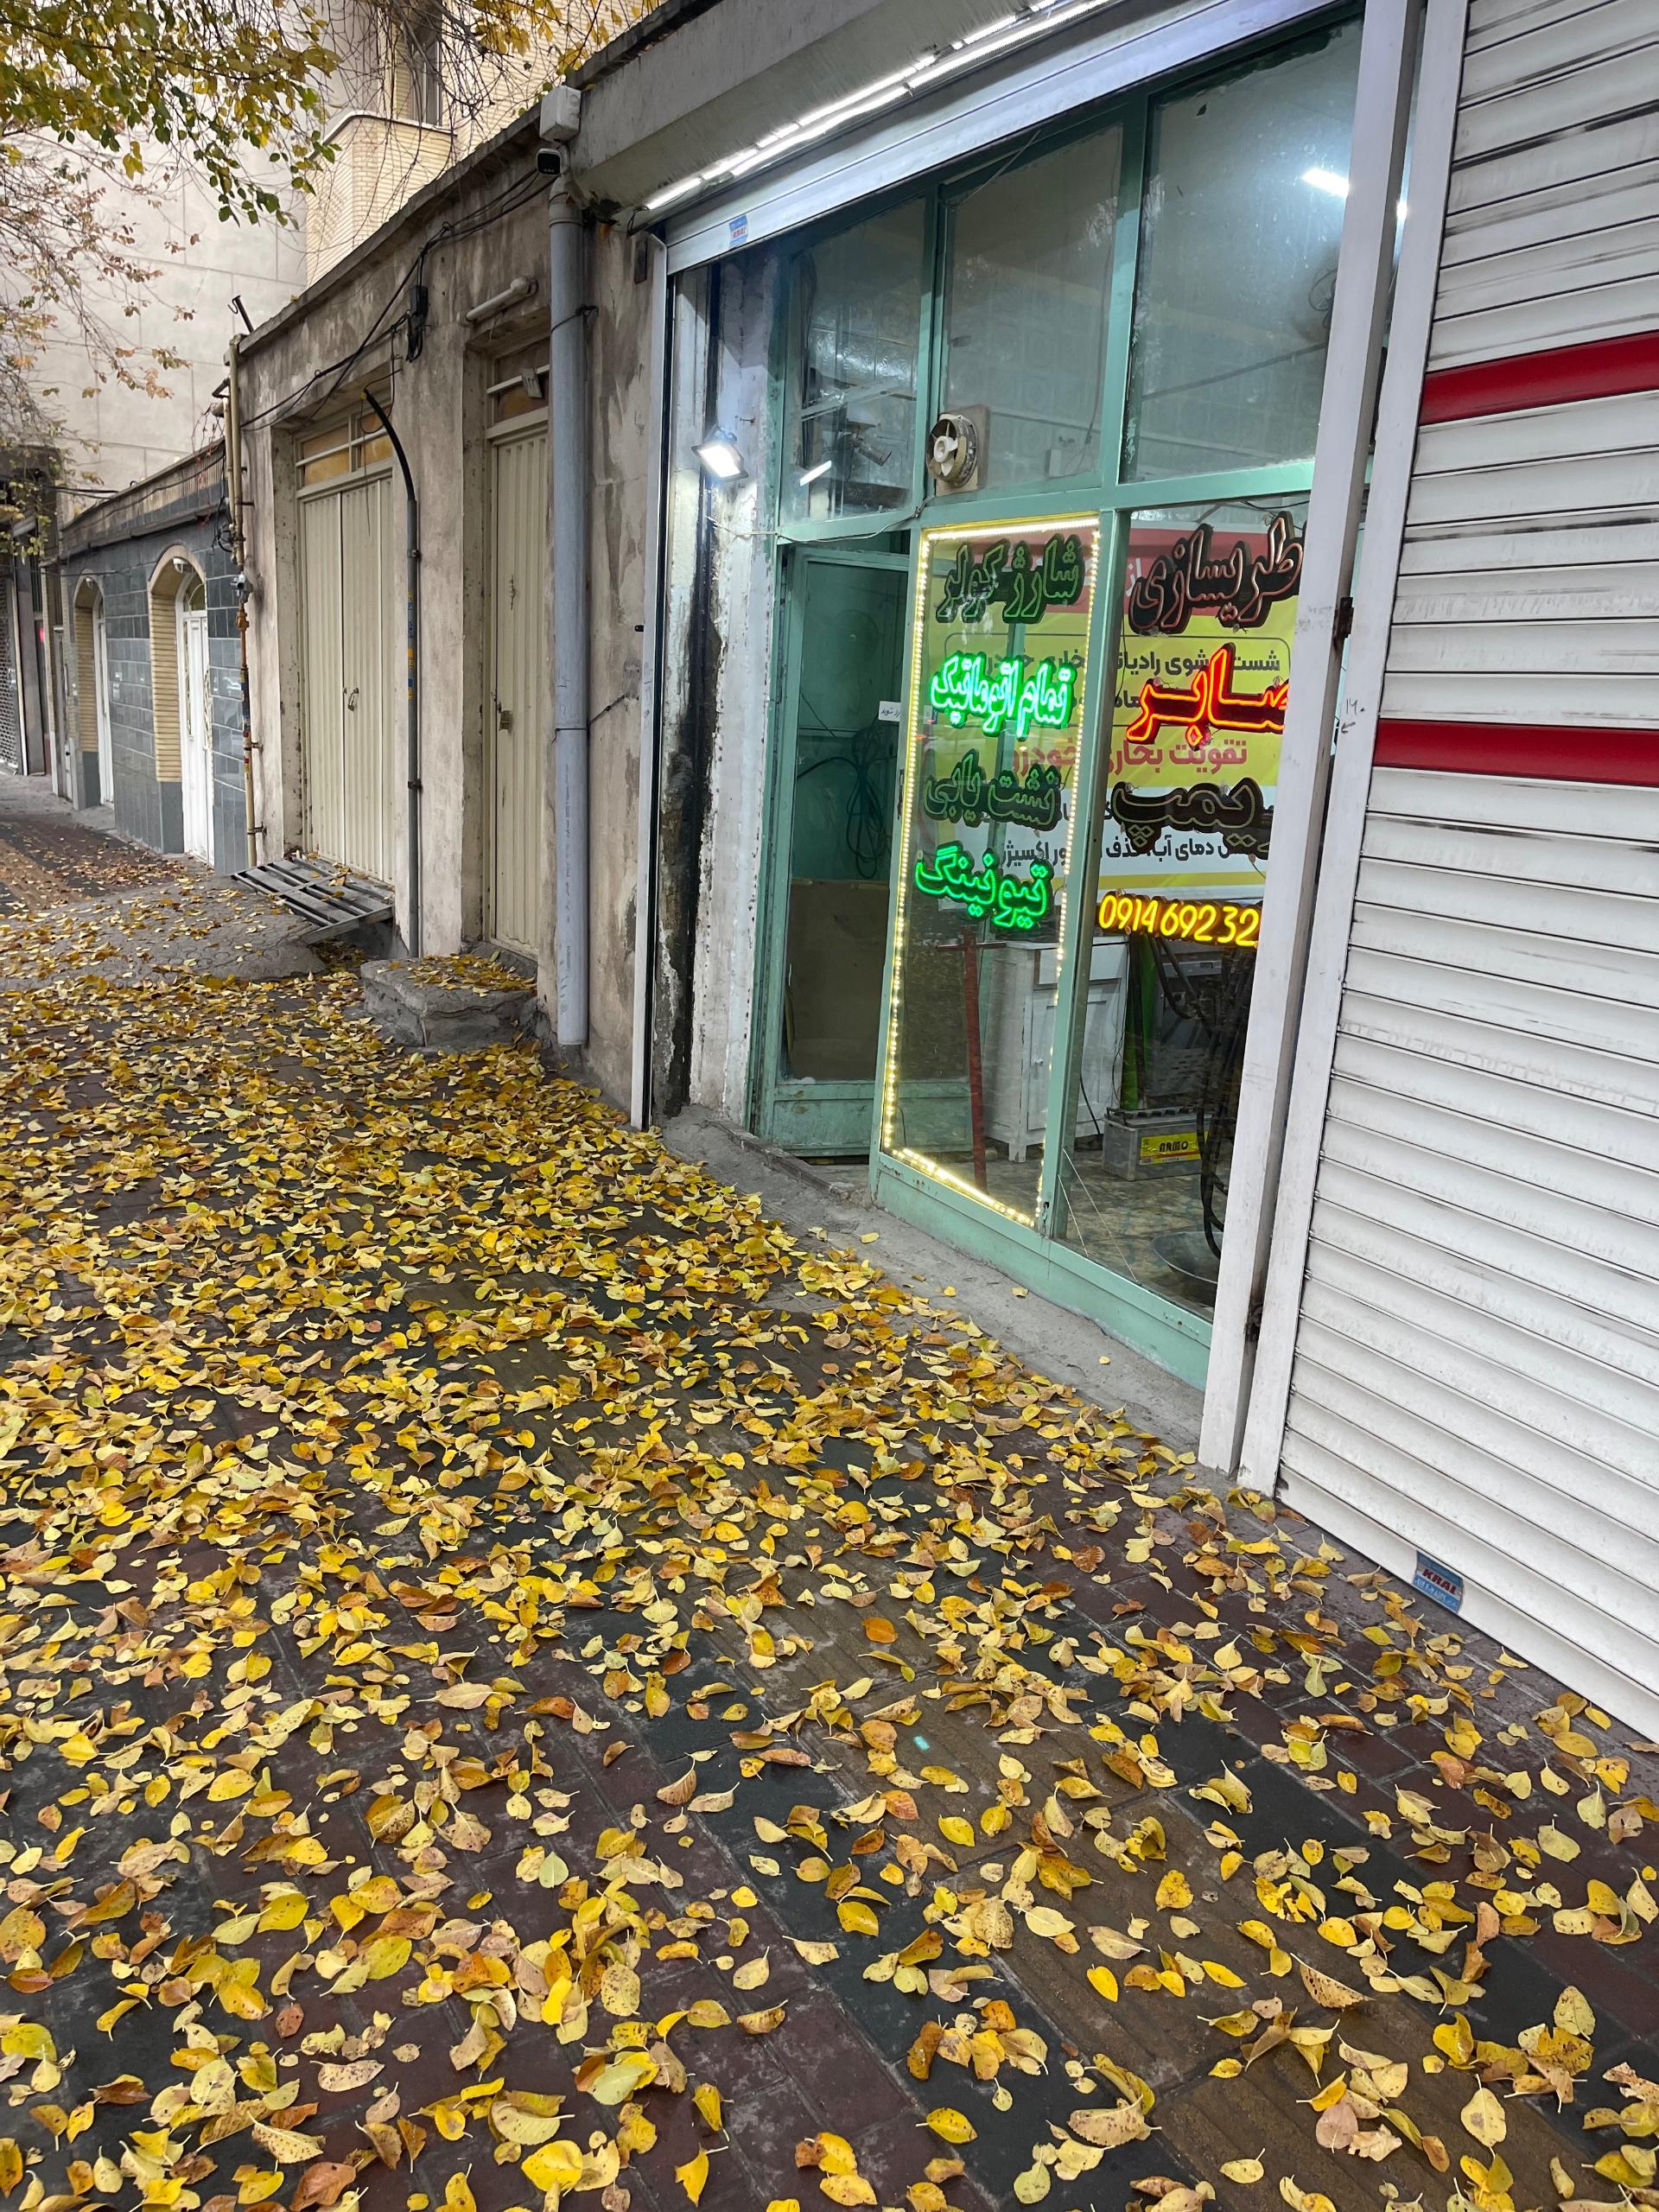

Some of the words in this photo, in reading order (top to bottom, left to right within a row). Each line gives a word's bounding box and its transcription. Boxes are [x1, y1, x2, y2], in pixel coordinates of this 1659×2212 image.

[936, 543, 1005, 618] کولر
[1003, 539, 1080, 618] شارژ
[1129, 516, 1303, 631] طریسازی
[931, 654, 1019, 734] اتوماتیک
[1015, 661, 1073, 741] تمام
[922, 753, 982, 823] یابی
[1169, 740, 1248, 774] تقویت
[987, 768, 1059, 826] نشت
[914, 844, 1049, 931] تیونینگ
[1175, 837, 1215, 861] دمای
